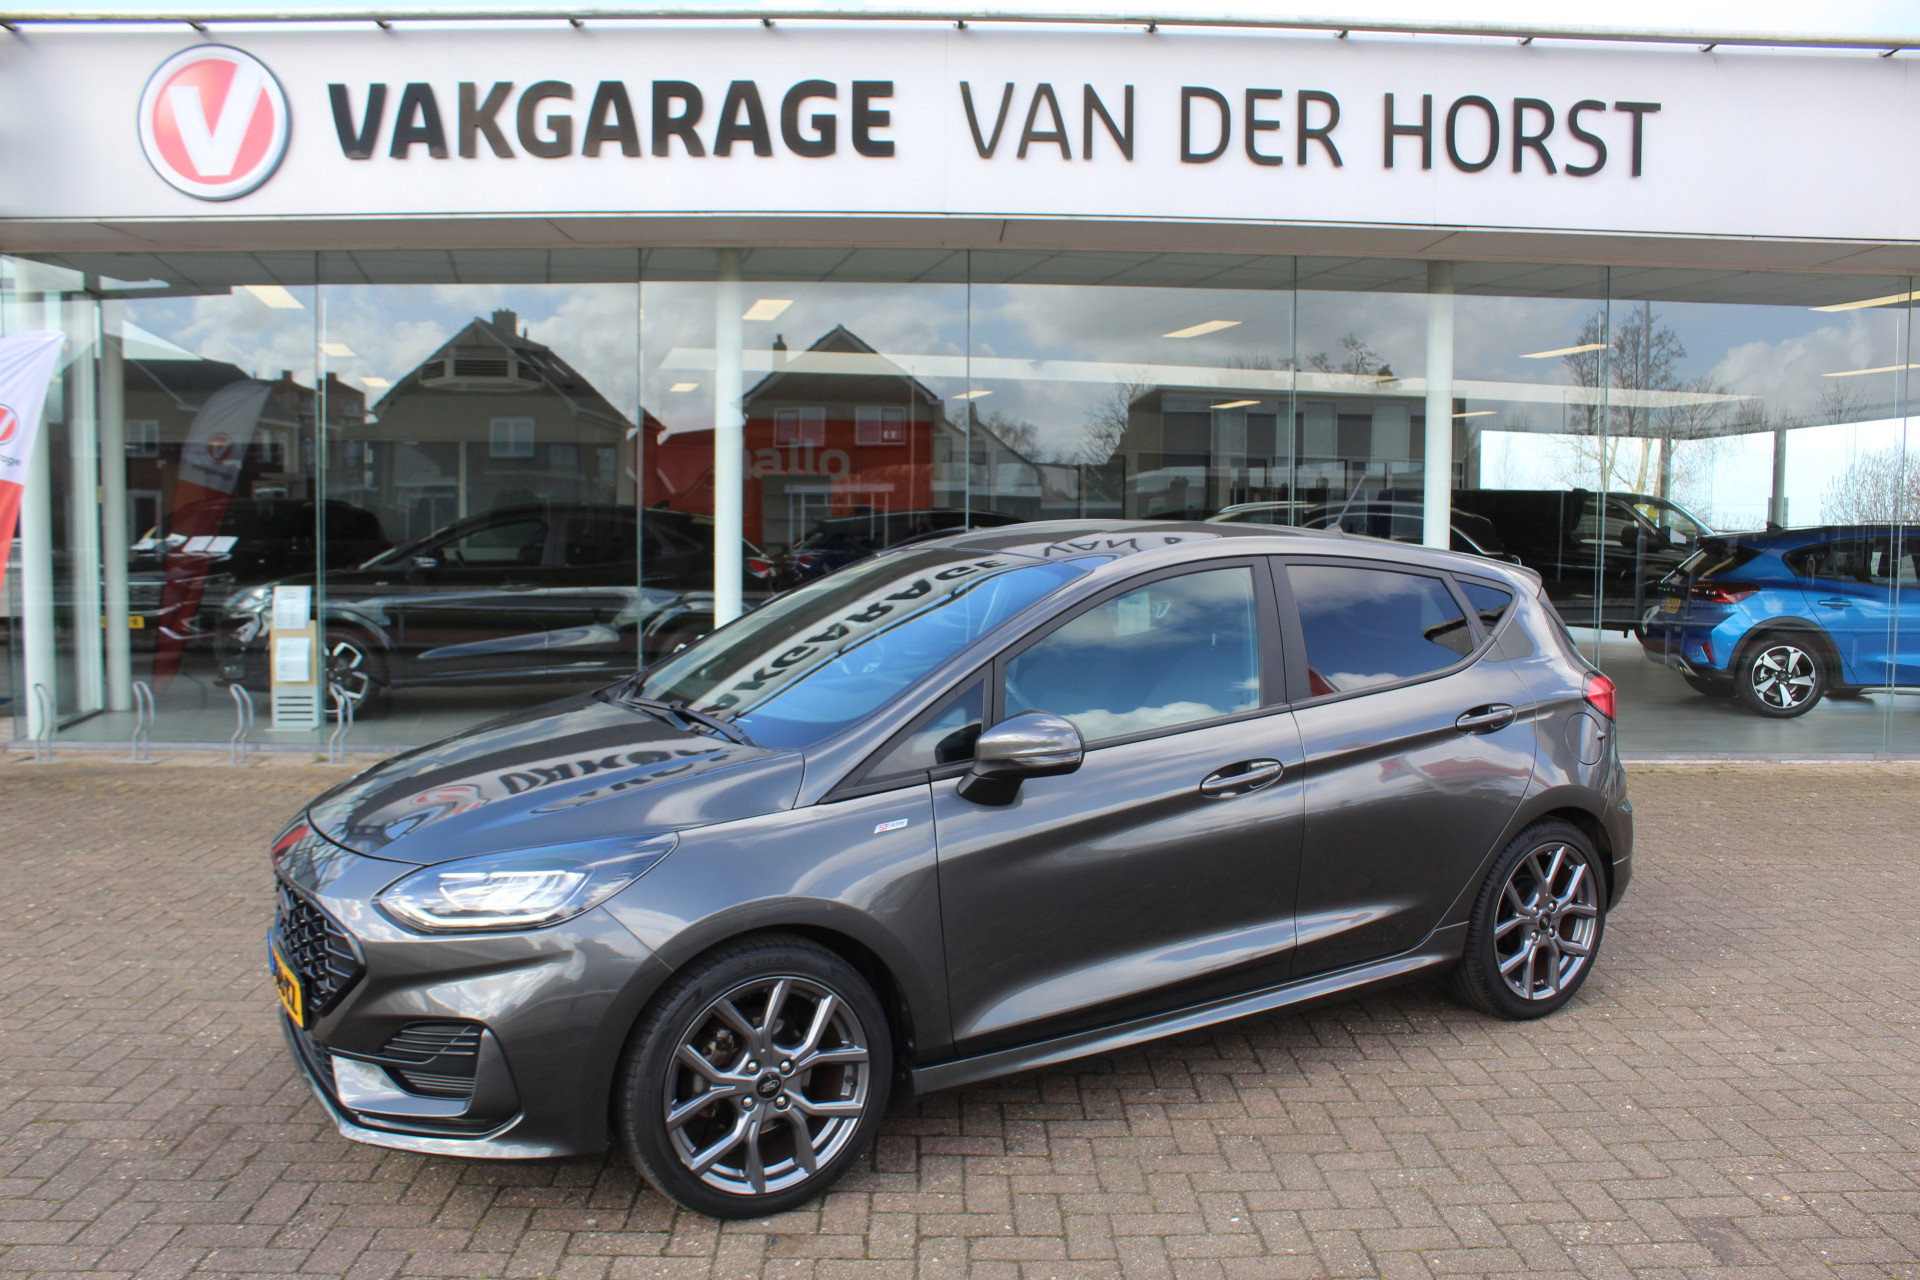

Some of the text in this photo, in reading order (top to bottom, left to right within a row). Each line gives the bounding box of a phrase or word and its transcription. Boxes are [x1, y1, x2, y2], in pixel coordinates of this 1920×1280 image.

[329, 80, 1661, 177] VAKGARAGE VAN DER HORST
[743, 438, 849, 480] allo
